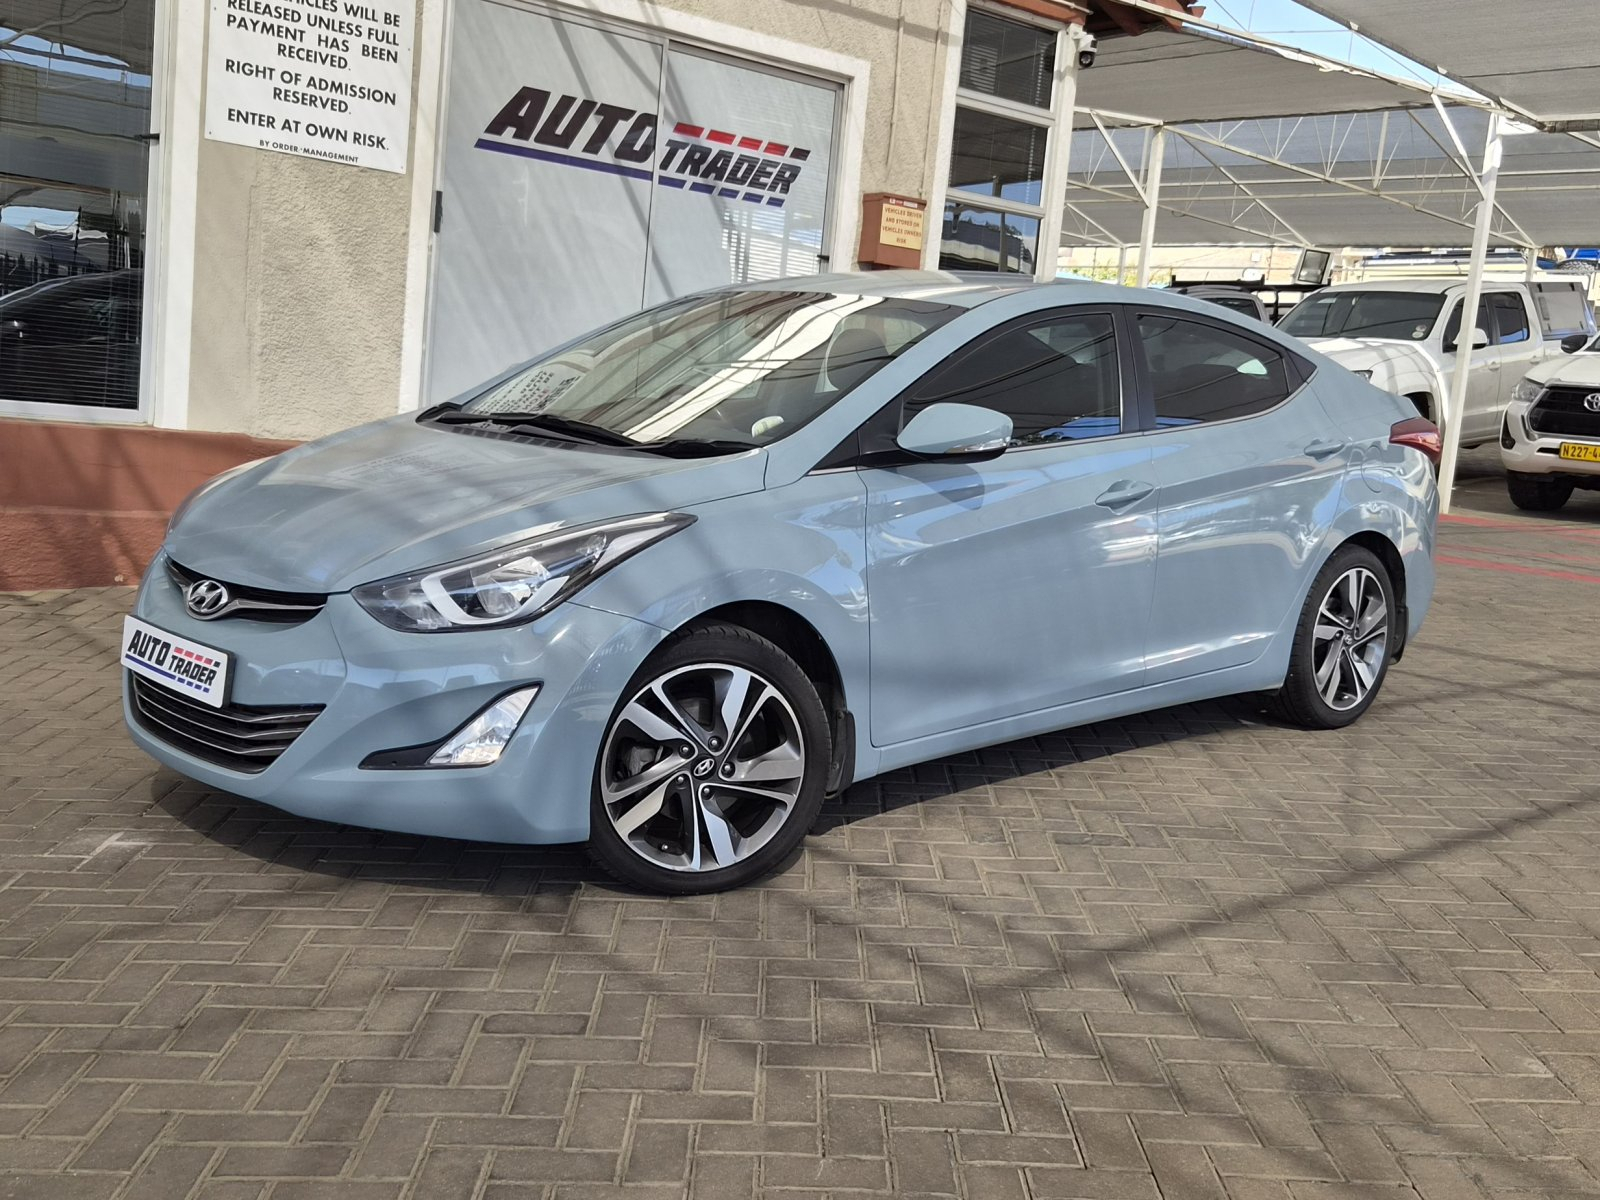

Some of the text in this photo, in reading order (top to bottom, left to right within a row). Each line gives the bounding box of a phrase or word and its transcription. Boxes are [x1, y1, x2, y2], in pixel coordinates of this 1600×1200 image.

[227, 0, 399, 46] RELEASED UNLESS FULL
[344, 2, 378, 22] WILL
[384, 12, 400, 27] BE
[226, 13, 398, 63] PAYMENT HAS BEEN
[277, 43, 351, 71] RECEIVED.
[225, 58, 397, 105] RIGHT OF ADMISSION
[273, 87, 351, 114] RESERVED.
[227, 108, 389, 150] ENTER AT OWN RISK.
[484, 86, 802, 194] AUTO TRADER
[259, 139, 359, 163] BY ORDER MANAGEMENT
[1562, 445, 1600, 459] N227-4
[127, 629, 218, 686] AUTO TRADER
